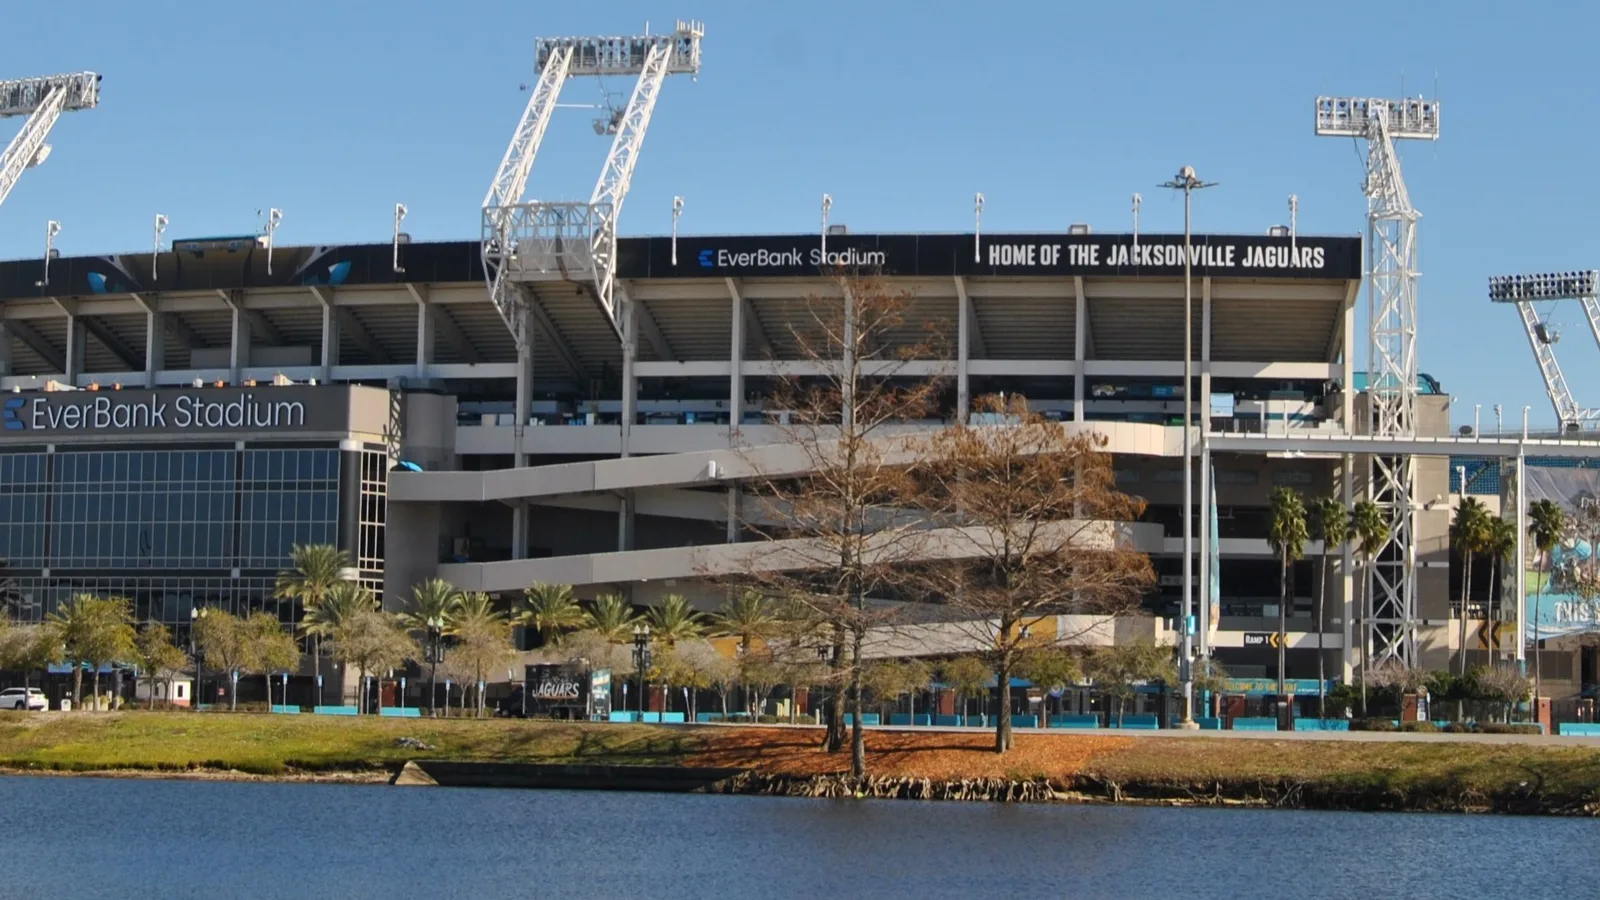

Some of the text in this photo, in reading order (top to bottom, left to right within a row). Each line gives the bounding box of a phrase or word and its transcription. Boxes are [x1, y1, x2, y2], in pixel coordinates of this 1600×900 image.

[718, 247, 885, 267] EverBank Sadium
[989, 244, 1324, 268] HOME OF THE JACKSONVILLE JAGUARS
[32, 393, 304, 430] EverBank Stadium
[1265, 636, 1269, 644] 1
[532, 682, 579, 698] JAGUARS
